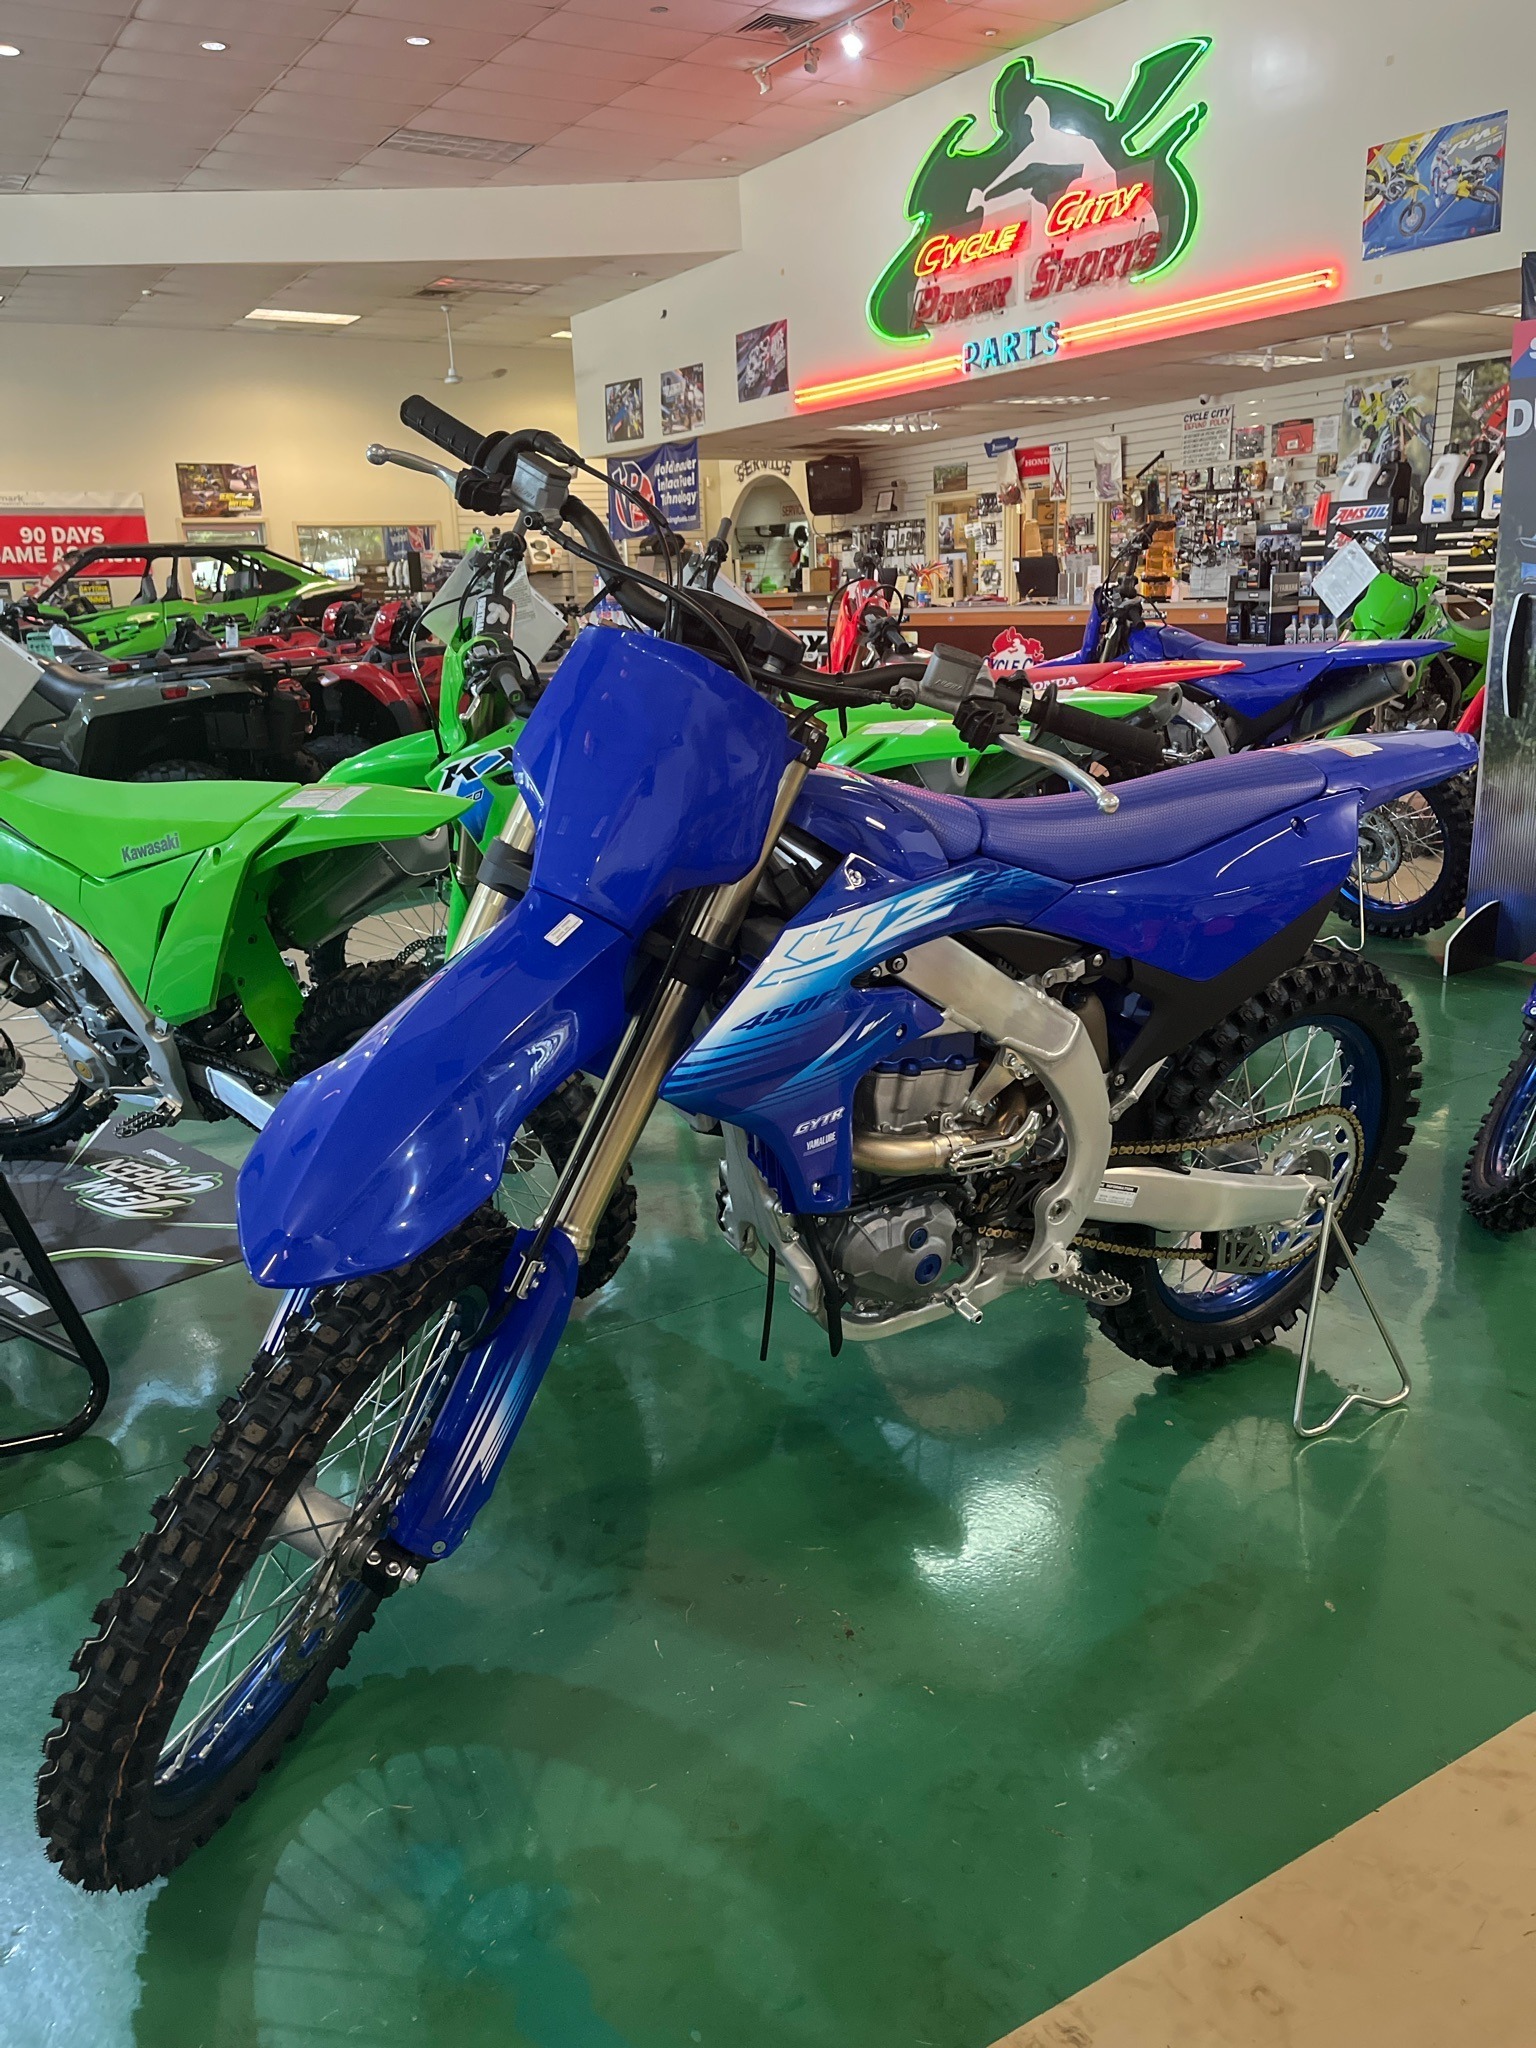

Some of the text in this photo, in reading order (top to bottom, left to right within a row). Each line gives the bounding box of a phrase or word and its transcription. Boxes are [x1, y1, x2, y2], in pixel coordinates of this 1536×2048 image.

[914, 182, 1152, 277] CYCLE CITY
[911, 232, 1163, 331] POWER SPORTS
[961, 321, 1060, 373] PARTS
[1183, 407, 1231, 423] CYCLE CITY
[1025, 457, 1050, 467] HOND
[1331, 504, 1389, 524] AMSOIL
[20, 526, 105, 544] 90 DAYS
[0, 546, 48, 564] AME
[1031, 676, 1079, 692] ONDA
[121, 832, 181, 864] Kawasaki
[731, 985, 842, 1031] 450F
[793, 1106, 846, 1137] GYTR
[806, 1131, 836, 1151] YAMALUBE
[89, 1158, 215, 1195] GREEN
[70, 1176, 187, 1218] TEAM
